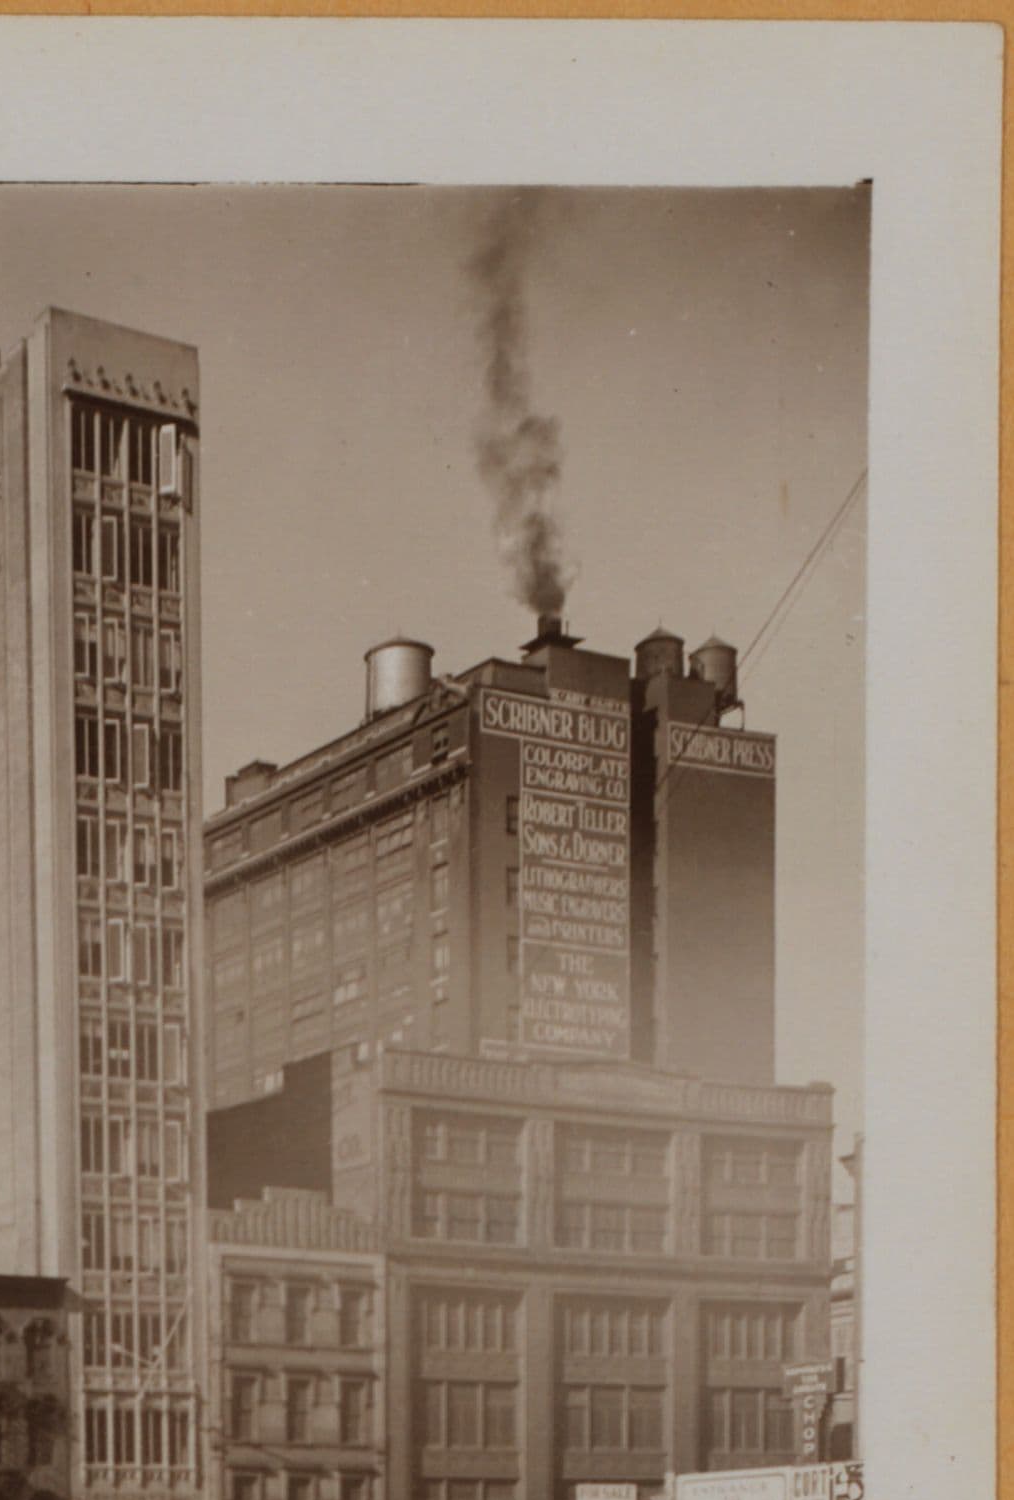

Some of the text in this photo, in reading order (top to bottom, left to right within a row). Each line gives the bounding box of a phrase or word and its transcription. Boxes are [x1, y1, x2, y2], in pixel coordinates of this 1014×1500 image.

[485, 696, 573, 740] SCRIBNER
[578, 711, 626, 748] BLDG
[524, 745, 627, 778] COLORPLATE
[671, 728, 773, 770] SCRIBNER PRESS
[526, 766, 602, 794] ENGRAVING
[523, 793, 627, 835] ROBERT TELLER
[524, 824, 558, 857] SONS
[573, 831, 626, 865] DORNER
[524, 864, 627, 898] LITHOGRAPHERS
[552, 920, 626, 945] PRINTERS
[555, 952, 594, 975] THE
[530, 972, 619, 1001] NEW YORK
[533, 1021, 618, 1048] COMPANY
[803, 1395, 815, 1456] CHOP
[602, 1487, 632, 1499] SALE
